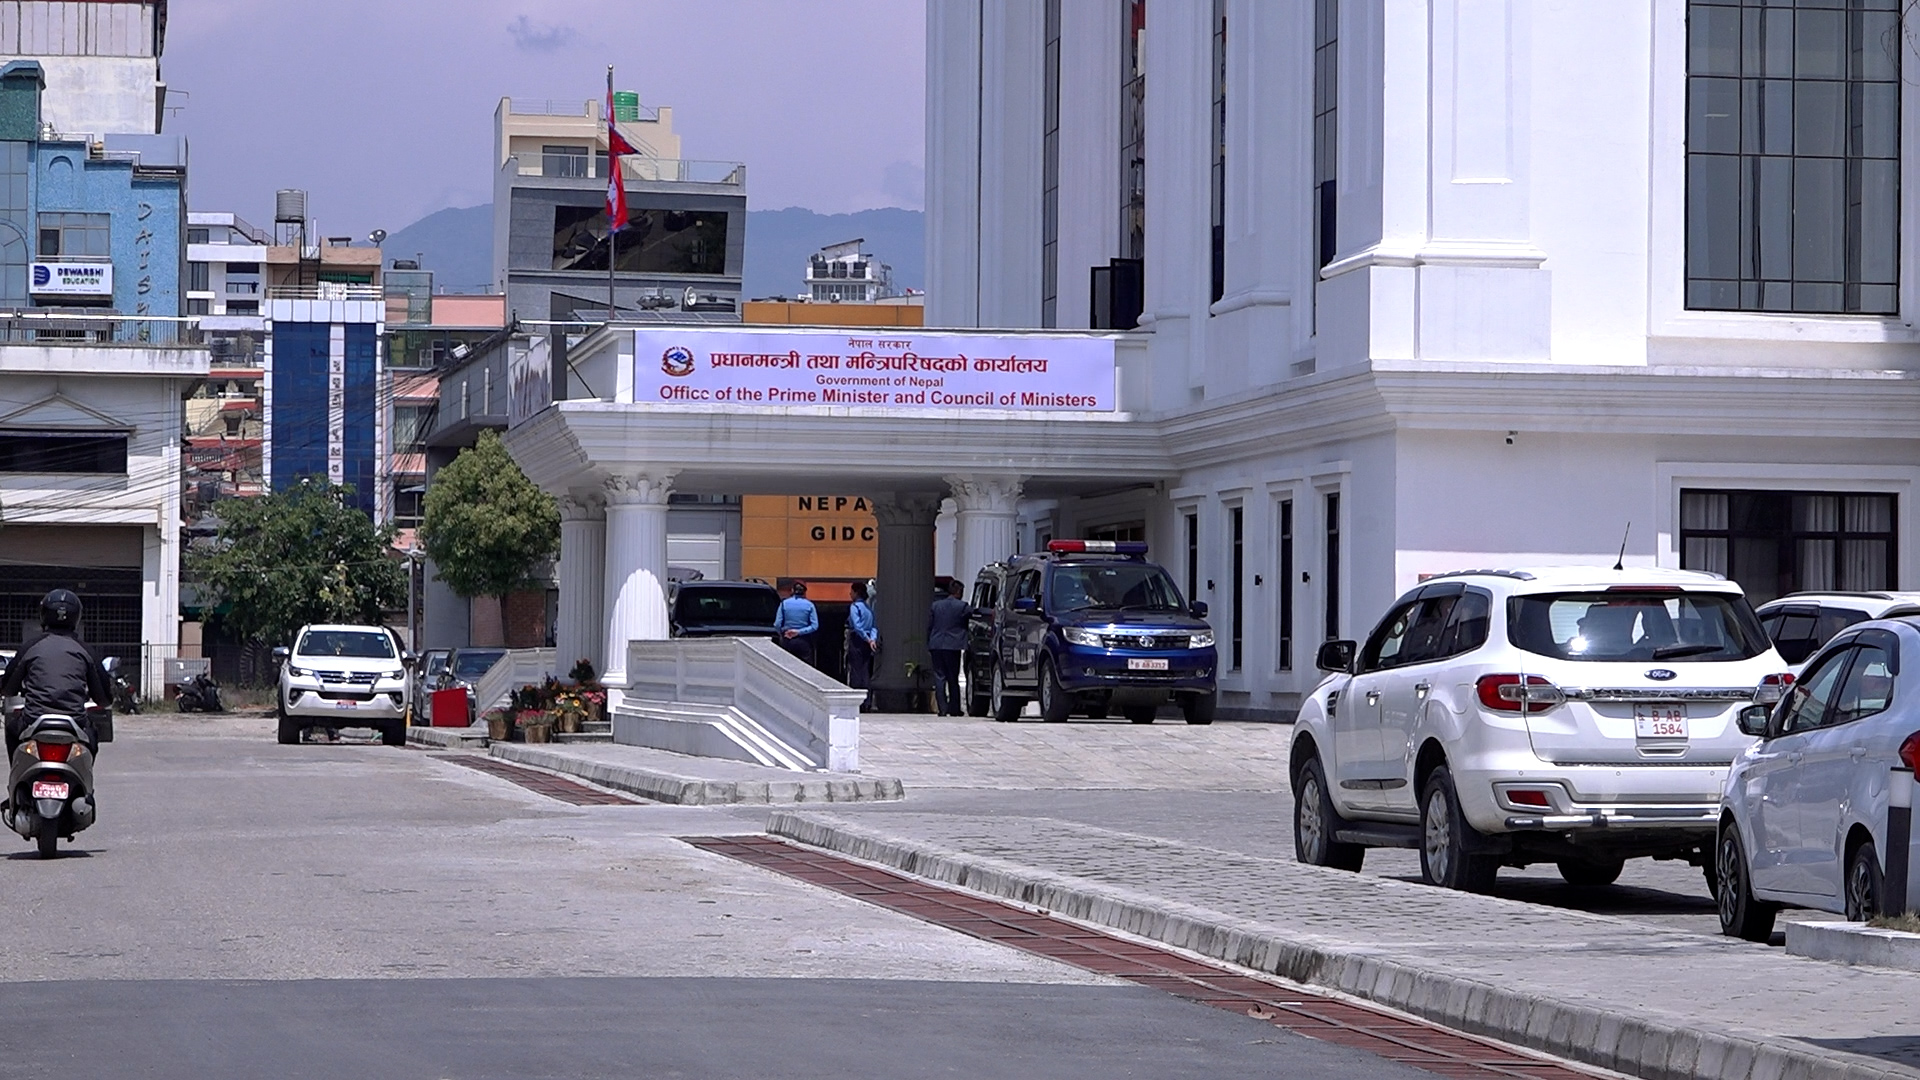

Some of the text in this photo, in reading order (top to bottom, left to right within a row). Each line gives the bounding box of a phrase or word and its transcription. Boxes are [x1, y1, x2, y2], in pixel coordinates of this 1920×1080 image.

[57, 267, 104, 277] DEWARSHI
[848, 337, 912, 350] नेपाल सरकार
[710, 350, 801, 369] प्रधानमन्त्री
[806, 354, 841, 369] तथा
[973, 355, 1048, 374] कार्यालय
[816, 374, 944, 389] Government of Nepal
[715, 387, 732, 400] of
[737, 387, 762, 401] the
[768, 388, 816, 402] Prime
[822, 389, 889, 403] Minister
[894, 390, 925, 404] and
[931, 391, 994, 405] Council
[999, 392, 1016, 405] of
[1021, 392, 1097, 407] Ministers
[811, 526, 875, 541] GIDC
[1652, 710, 1660, 722] B
[1666, 710, 1682, 722] AB
[1652, 723, 1683, 735] 1584
